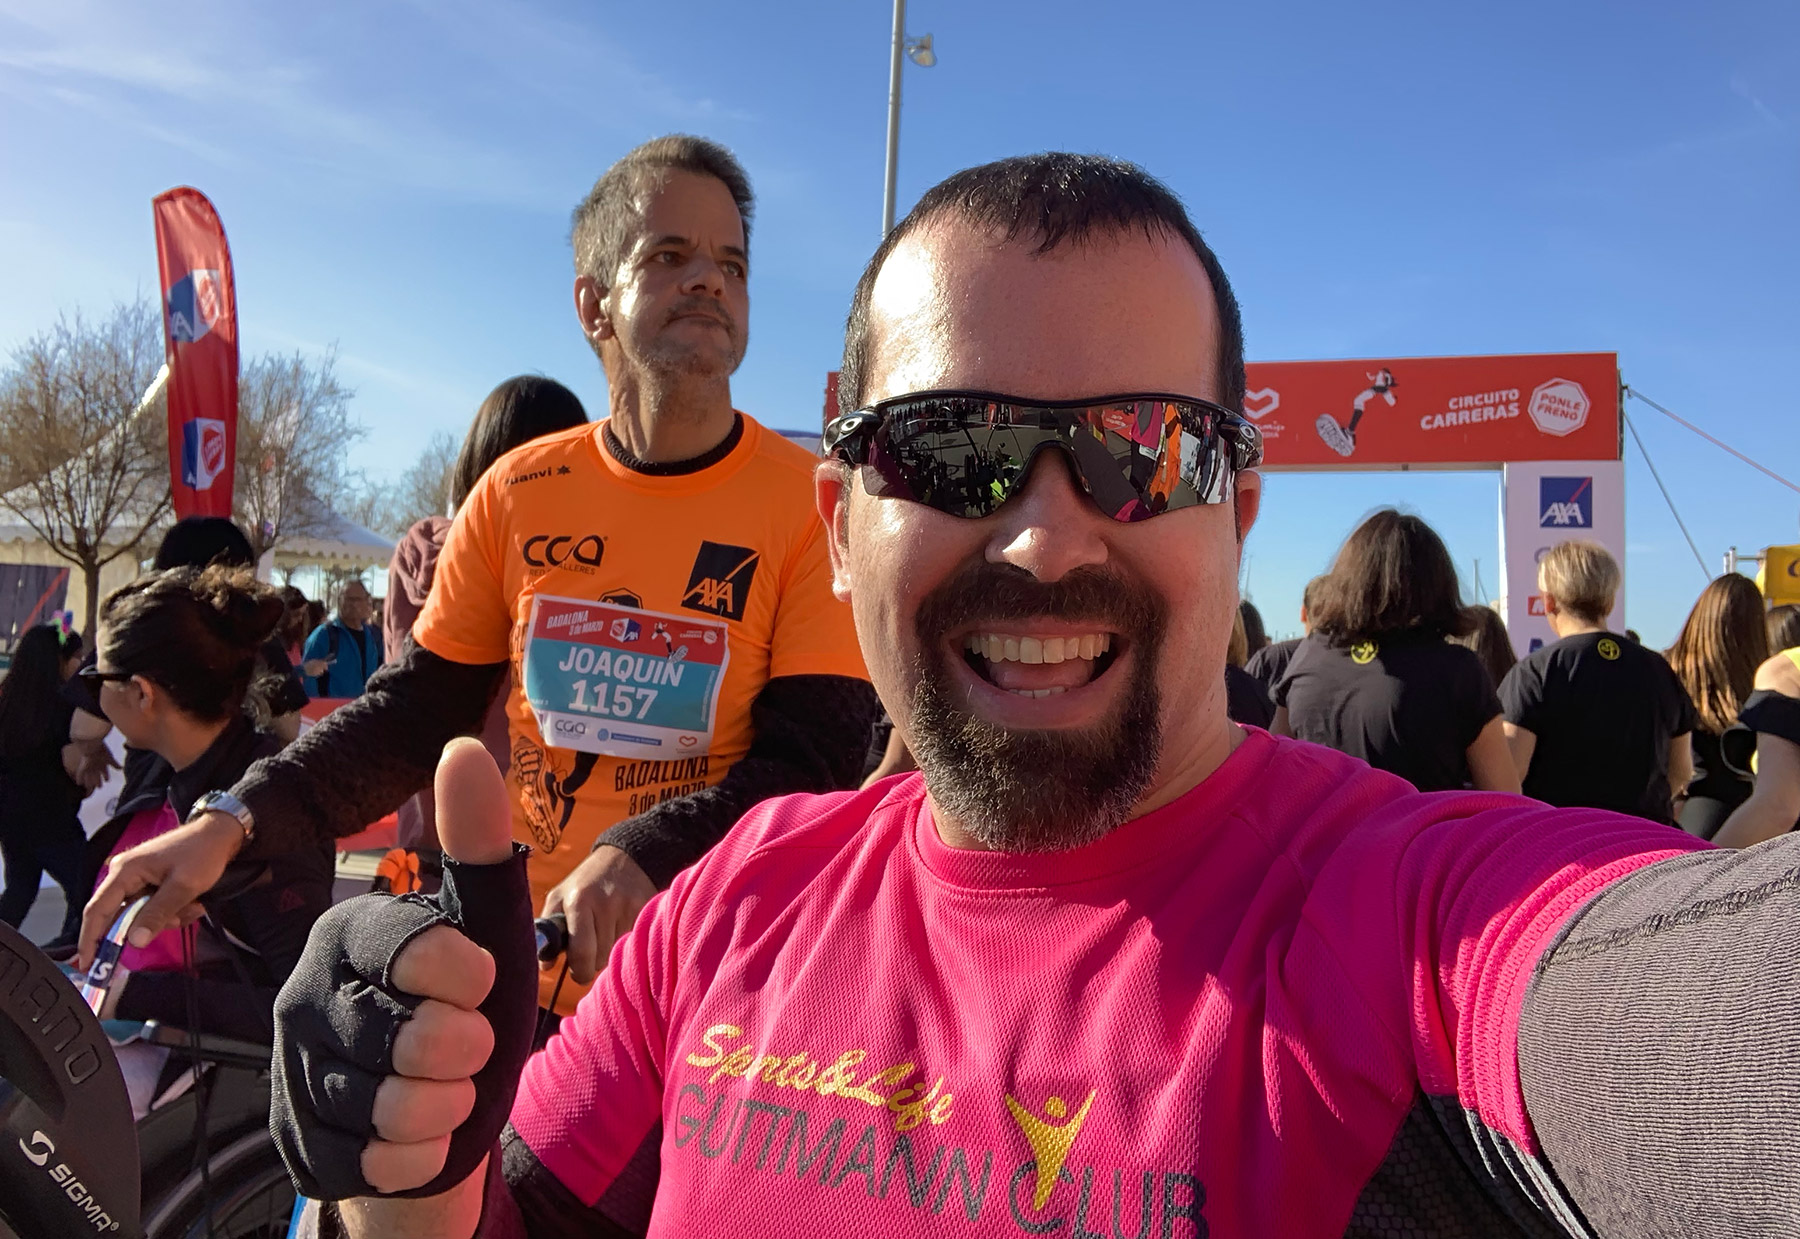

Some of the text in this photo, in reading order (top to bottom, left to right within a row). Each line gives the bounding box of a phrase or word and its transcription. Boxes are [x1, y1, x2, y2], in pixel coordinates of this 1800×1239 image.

[1448, 388, 1520, 410] CIRCUITO
[1536, 404, 1578, 421] FRENO
[1540, 393, 1582, 411] PONLE
[1420, 402, 1520, 431] CARRERAS
[1540, 502, 1584, 525] AXA
[683, 577, 734, 613] AXA
[546, 610, 589, 629] BADALONA
[558, 646, 685, 687] JOAQUIN
[568, 679, 658, 720] 1157
[614, 756, 709, 792] BADALONA
[675, 1083, 1210, 1239] GUTTMANN CLUB
[48, 1163, 112, 1233] SIGMA
